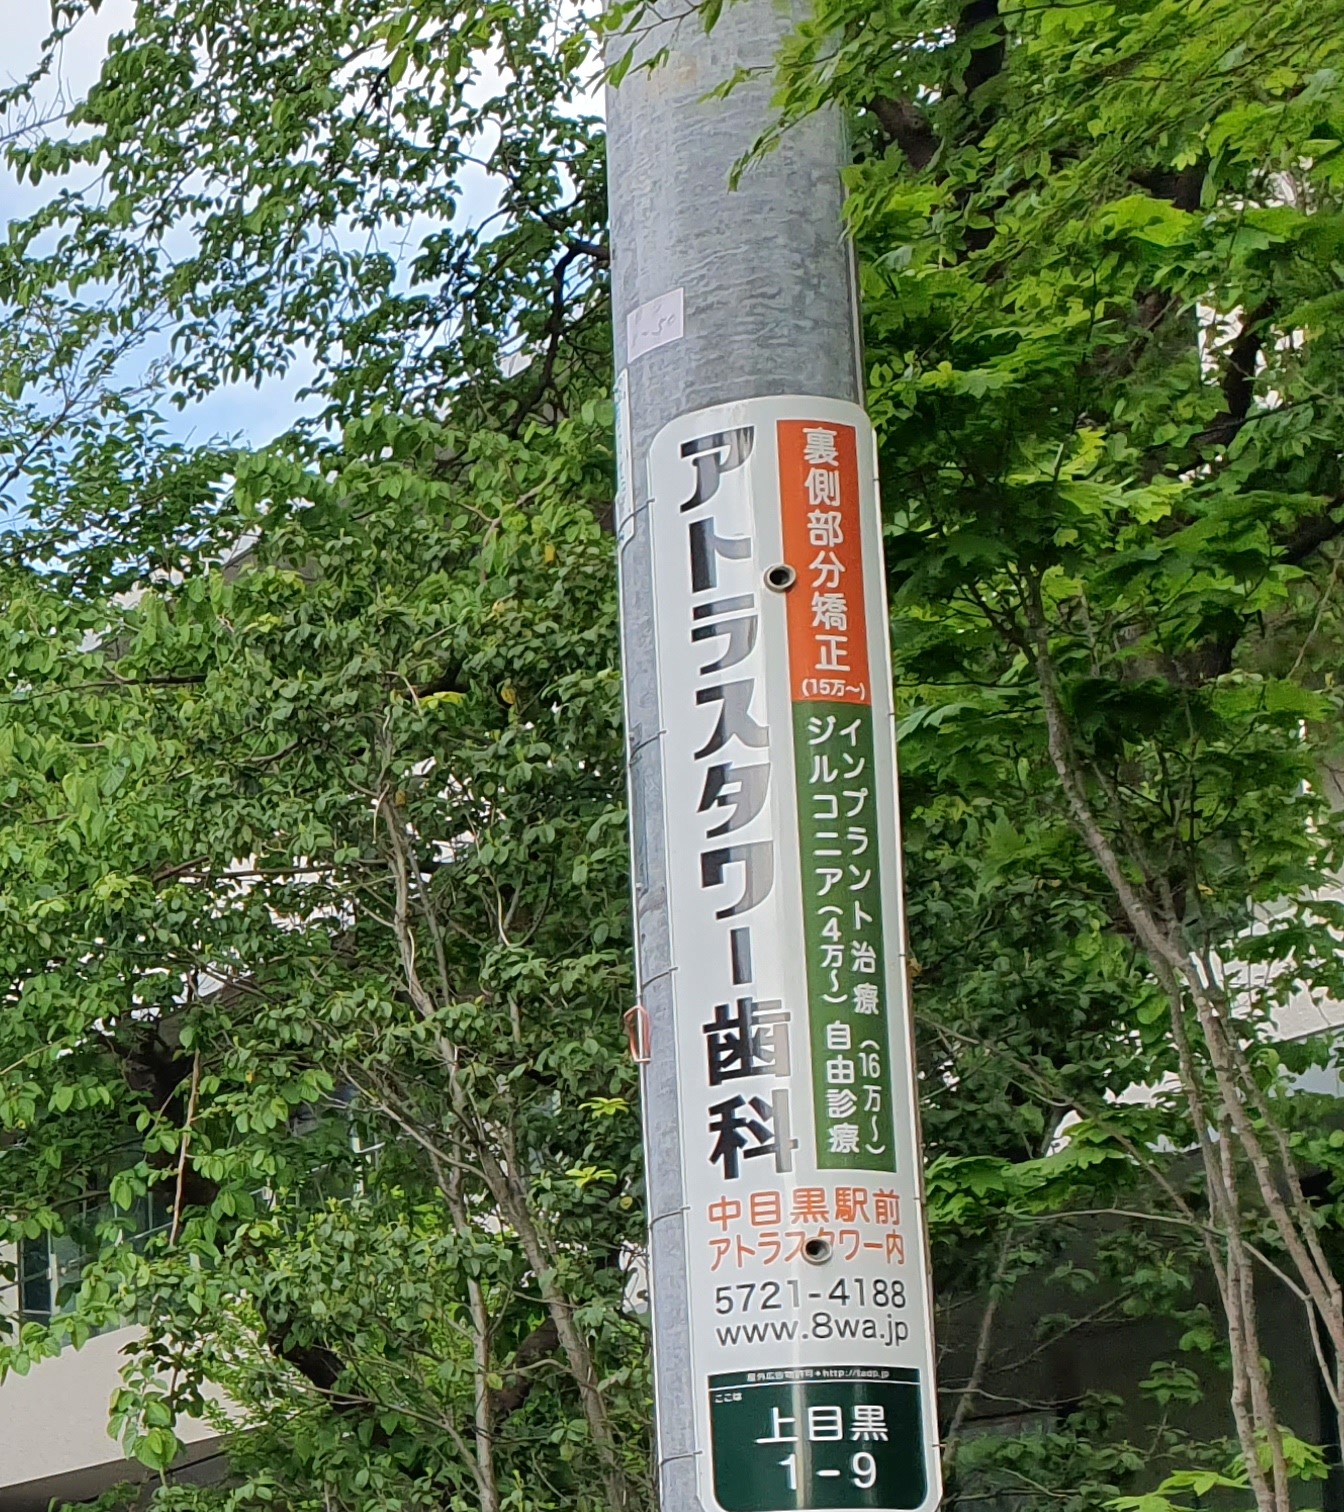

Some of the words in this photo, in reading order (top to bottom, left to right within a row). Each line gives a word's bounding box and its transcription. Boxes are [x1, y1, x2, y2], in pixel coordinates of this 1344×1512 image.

[801, 426, 851, 672] 裏側部分矯正
[679, 424, 799, 1181] アトラスタワー歯科
[707, 1186, 901, 1232] 中目黒駅前
[715, 1277, 907, 1315] 5721-4188
[716, 1311, 910, 1347] www.8wa.jp
[753, 1404, 890, 1445] 上目黒
[777, 1450, 878, 1491] 1-9
